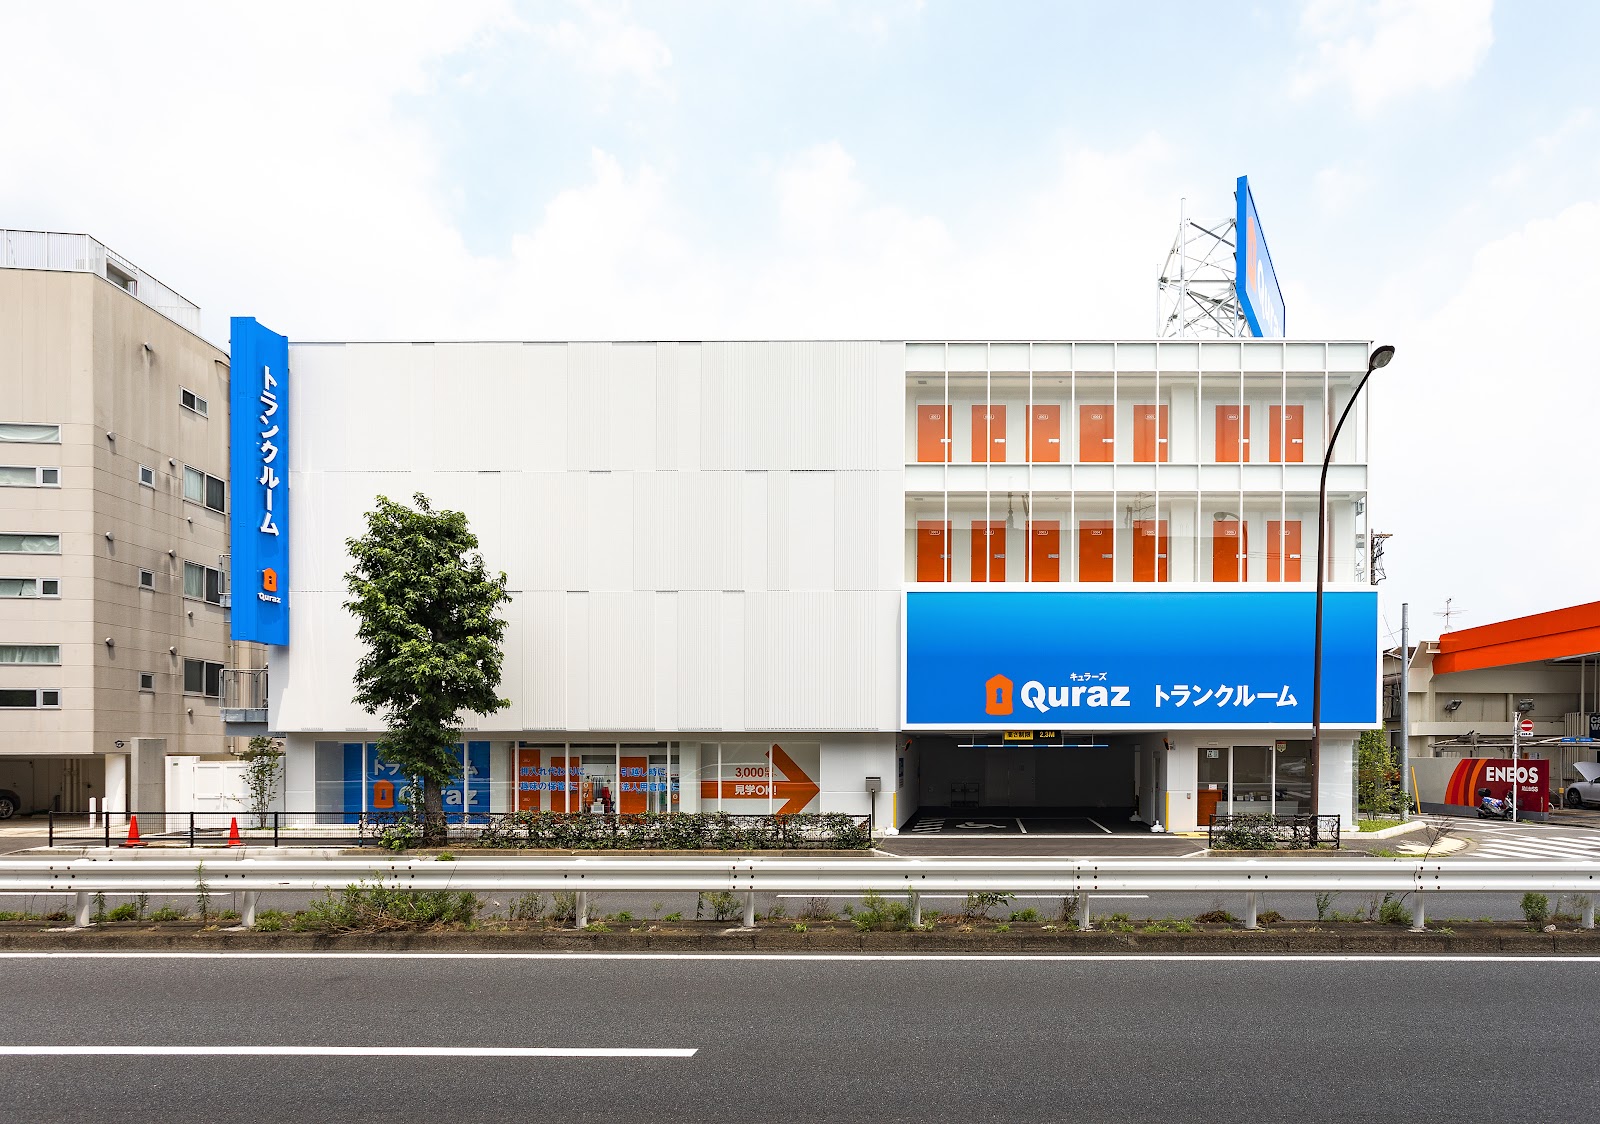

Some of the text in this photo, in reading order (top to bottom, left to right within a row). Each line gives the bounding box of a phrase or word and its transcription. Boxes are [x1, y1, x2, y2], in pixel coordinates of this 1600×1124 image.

[259, 365, 280, 537] トランクルーム
[257, 592, 282, 604] Quraz
[1070, 672, 1108, 682] キュラーズ
[1020, 680, 1131, 713] Quraz
[1155, 684, 1299, 708] トランクルーム
[735, 767, 764, 778] 3,000
[1486, 766, 1539, 784] ENEOS
